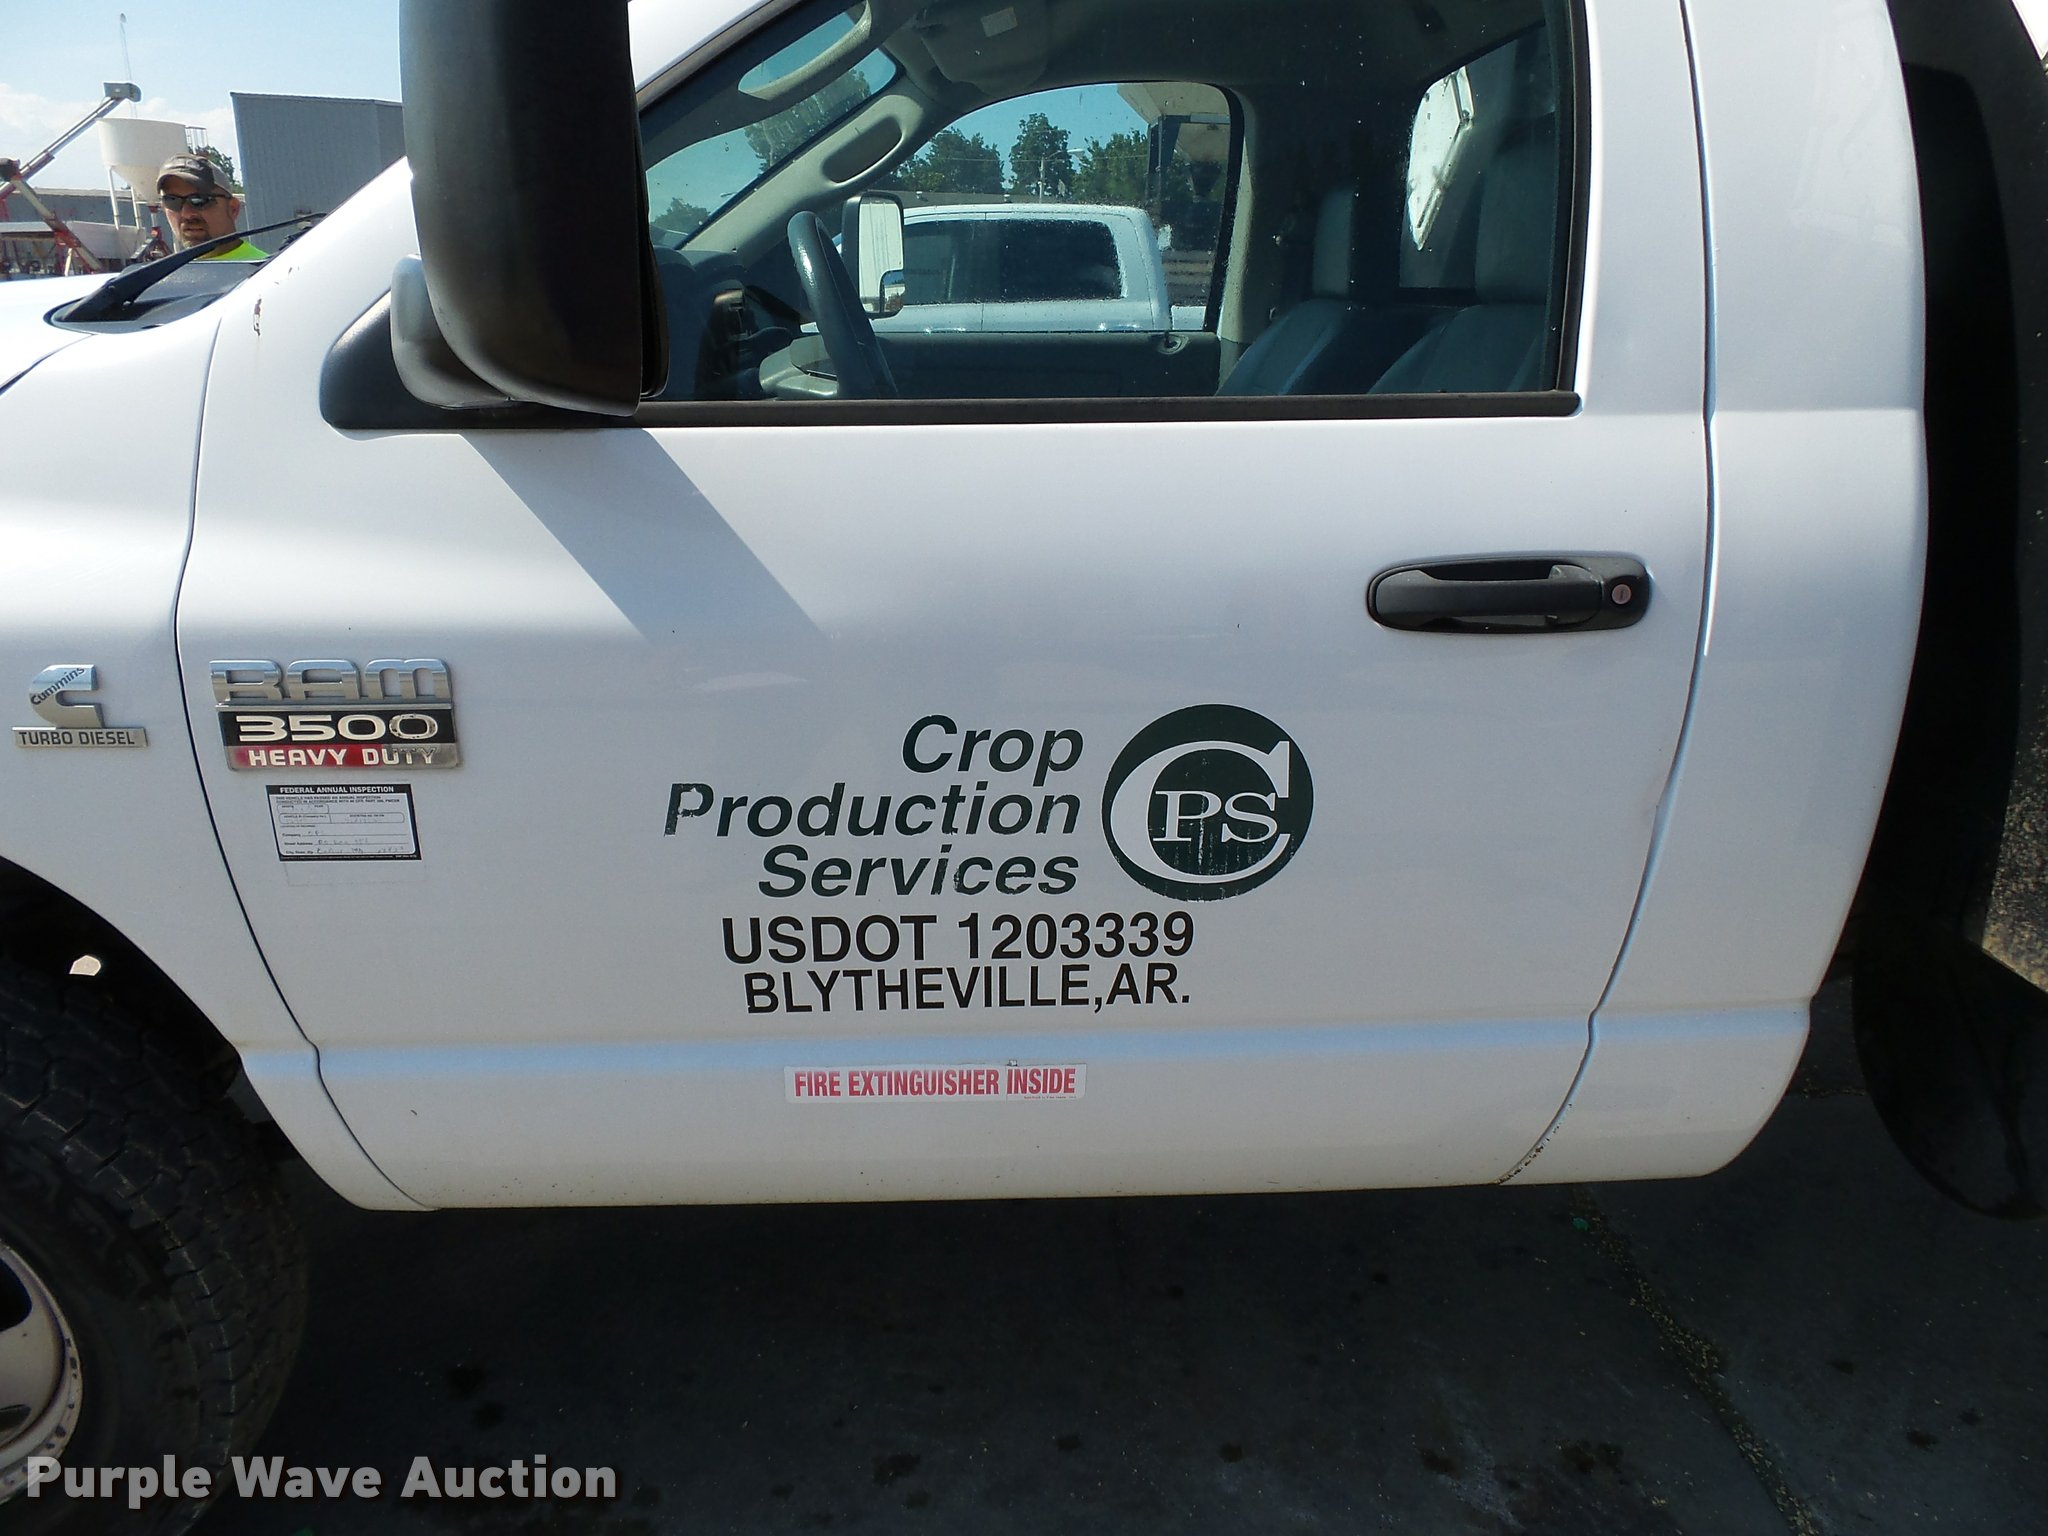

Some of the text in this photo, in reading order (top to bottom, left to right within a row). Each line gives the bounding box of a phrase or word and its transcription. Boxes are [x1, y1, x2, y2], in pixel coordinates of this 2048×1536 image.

[30, 667, 85, 705] Cummins
[209, 658, 453, 702] RAM
[19, 731, 135, 745] TURBO DIESEL
[236, 713, 438, 742] 3500
[248, 747, 436, 766] HEAVY DUTY
[902, 714, 1083, 786] Crop
[280, 786, 315, 794] FEDERAL
[349, 785, 395, 793] INSPECTION
[664, 781, 1081, 838] Production
[758, 843, 1079, 897] Services
[722, 910, 1194, 964] USDOT 1203339
[744, 961, 1191, 1014] BLYTHEVILLE,AR.
[794, 1068, 1076, 1097] FIRE EXTINGUISHER INSIDE
